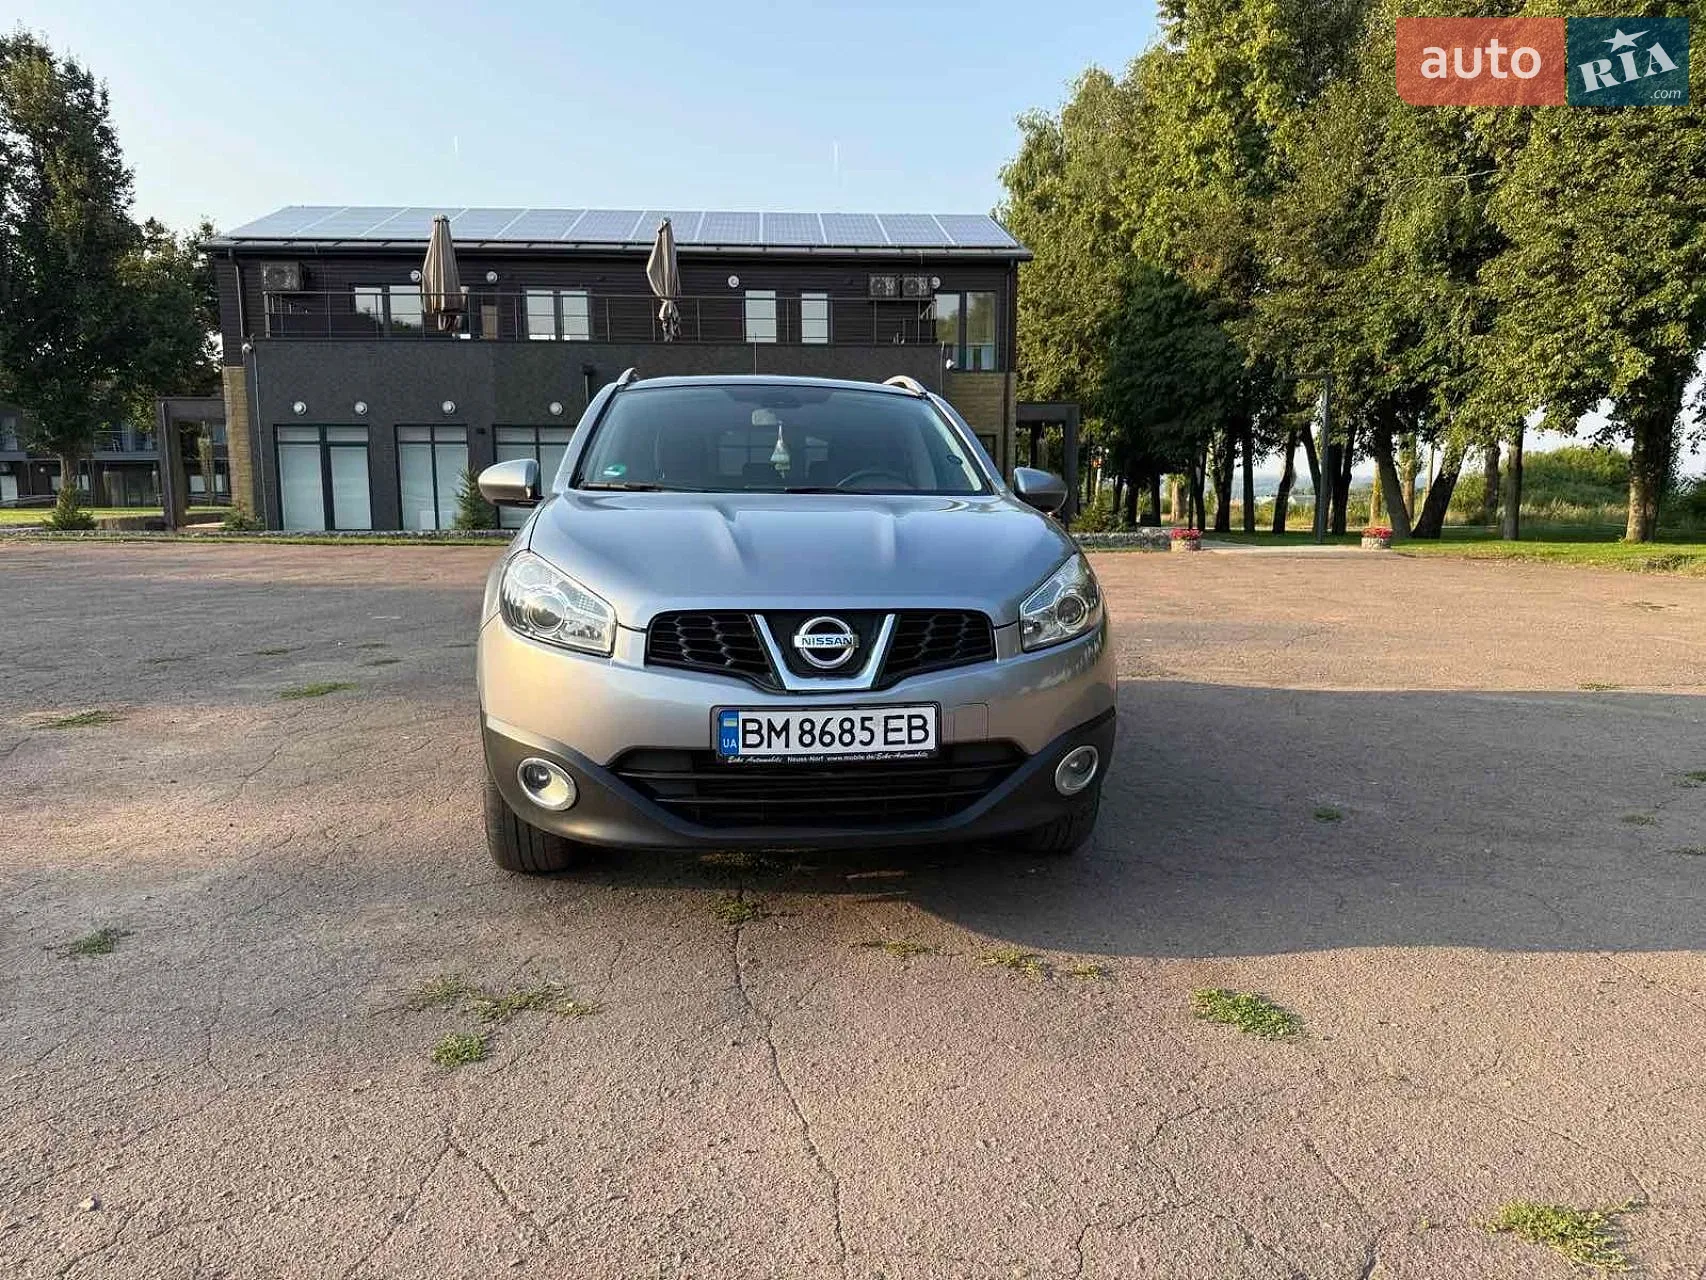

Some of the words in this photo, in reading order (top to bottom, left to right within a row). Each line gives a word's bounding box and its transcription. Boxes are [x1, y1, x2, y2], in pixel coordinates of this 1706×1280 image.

[802, 637, 853, 645] NISSAN
[742, 718, 790, 748] BM
[798, 716, 875, 748] 8685
[883, 714, 929, 746] EB
[723, 739, 737, 748] UA
